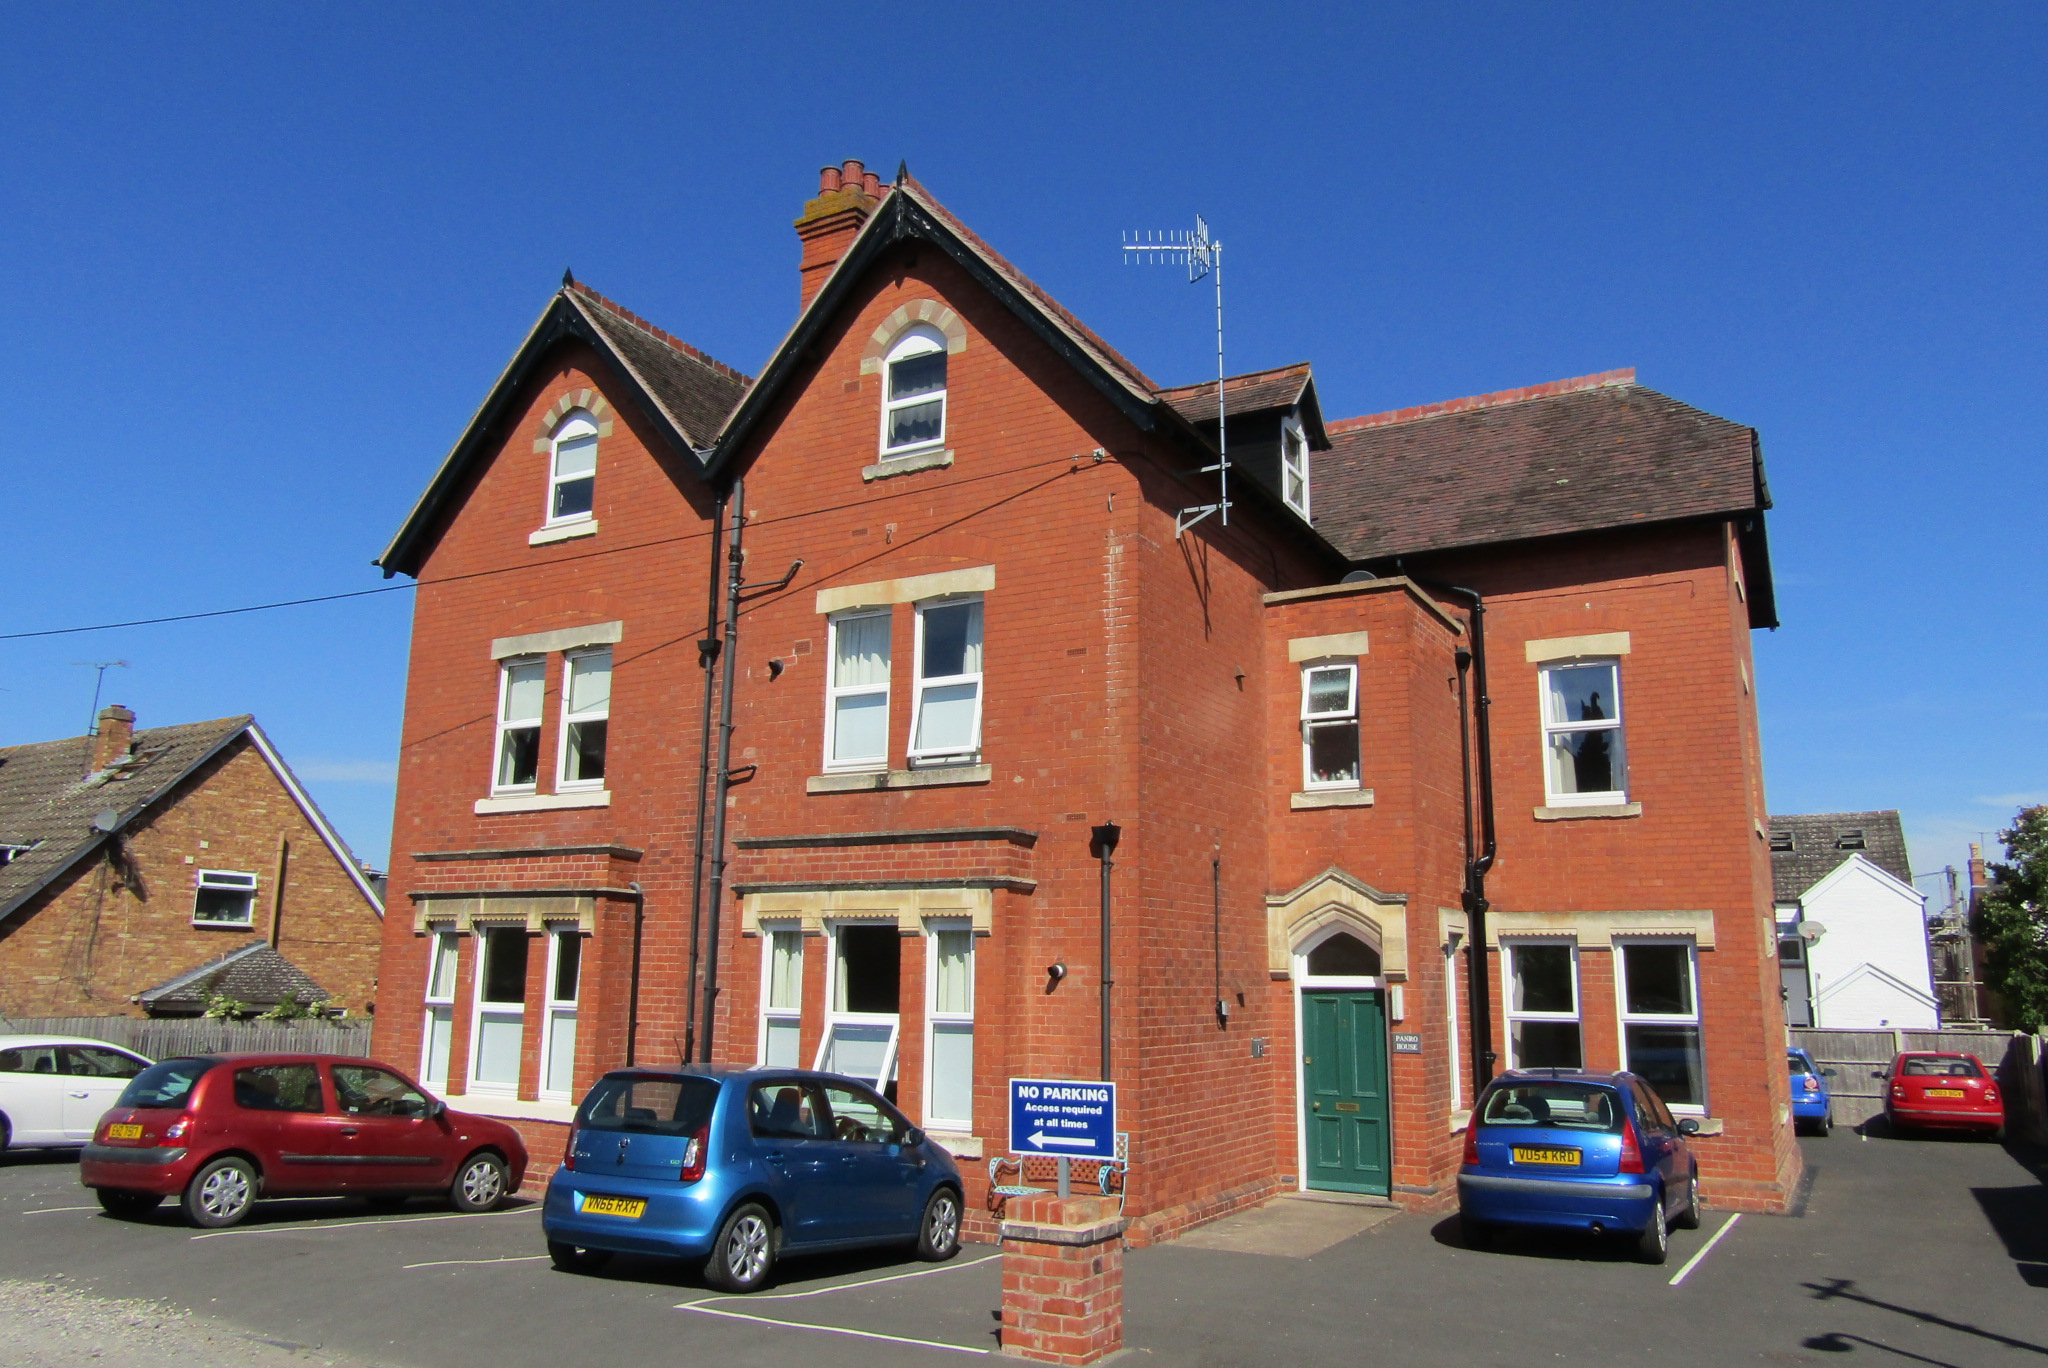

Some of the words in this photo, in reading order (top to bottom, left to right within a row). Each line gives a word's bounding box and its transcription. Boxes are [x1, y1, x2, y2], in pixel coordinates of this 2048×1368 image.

[1395, 1035, 1418, 1043] PANRO
[1018, 1086, 1040, 1099] NO
[1043, 1087, 1109, 1101] PARKING
[1025, 1102, 1060, 1113] Access
[1062, 1105, 1102, 1115] required
[1034, 1118, 1044, 1126] at
[1046, 1119, 1058, 1127] all
[1061, 1119, 1088, 1129] times
[1519, 1149, 1548, 1161] VU54
[1551, 1150, 1575, 1162] KRD
[588, 1196, 615, 1211] VN66
[615, 1199, 639, 1214] RXH
